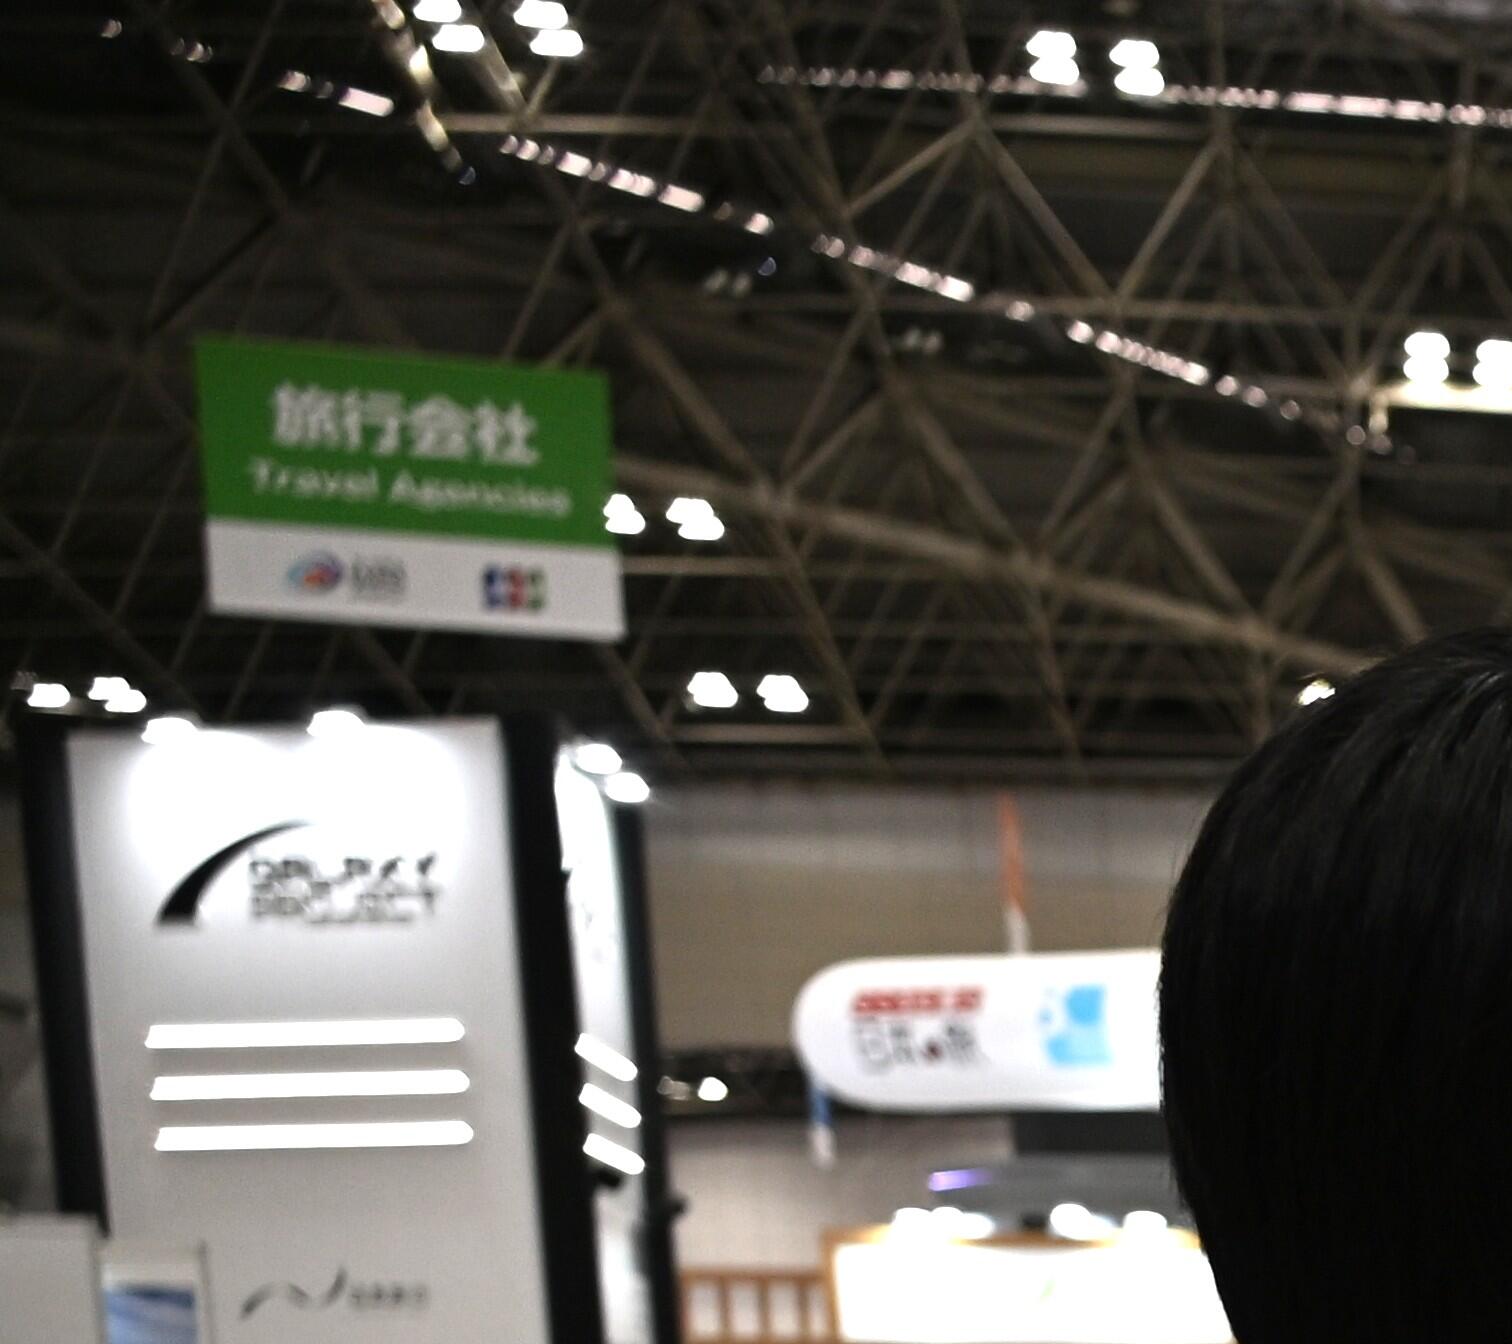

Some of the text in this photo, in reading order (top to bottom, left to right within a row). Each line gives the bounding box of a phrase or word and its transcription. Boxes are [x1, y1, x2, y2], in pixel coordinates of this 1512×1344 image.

[272, 380, 541, 467] 旅行会社
[250, 456, 572, 519] Travel Agencies
